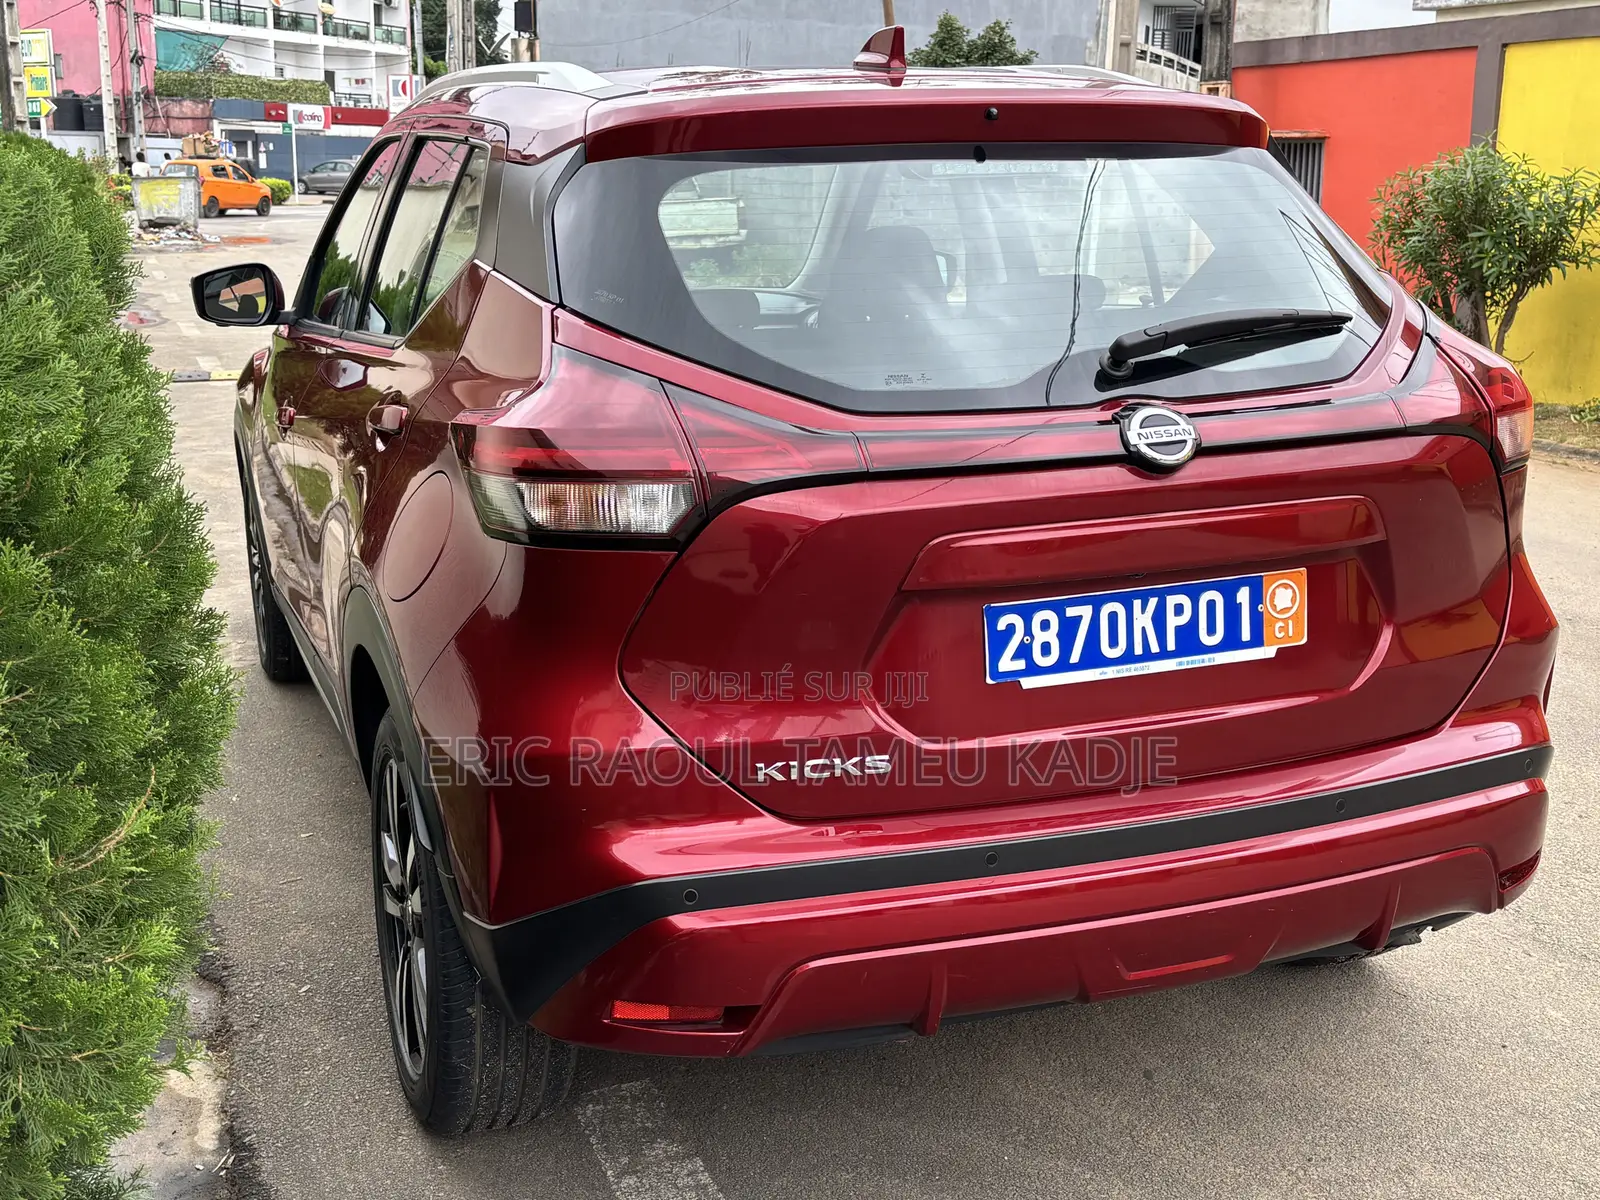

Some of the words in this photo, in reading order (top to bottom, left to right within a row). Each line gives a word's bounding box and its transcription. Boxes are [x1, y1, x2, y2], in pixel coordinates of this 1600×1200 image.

[1137, 428, 1192, 441] NISSAN
[995, 586, 1251, 673] 2870KP01
[1273, 621, 1293, 639] CI
[755, 754, 893, 784] KICKS
